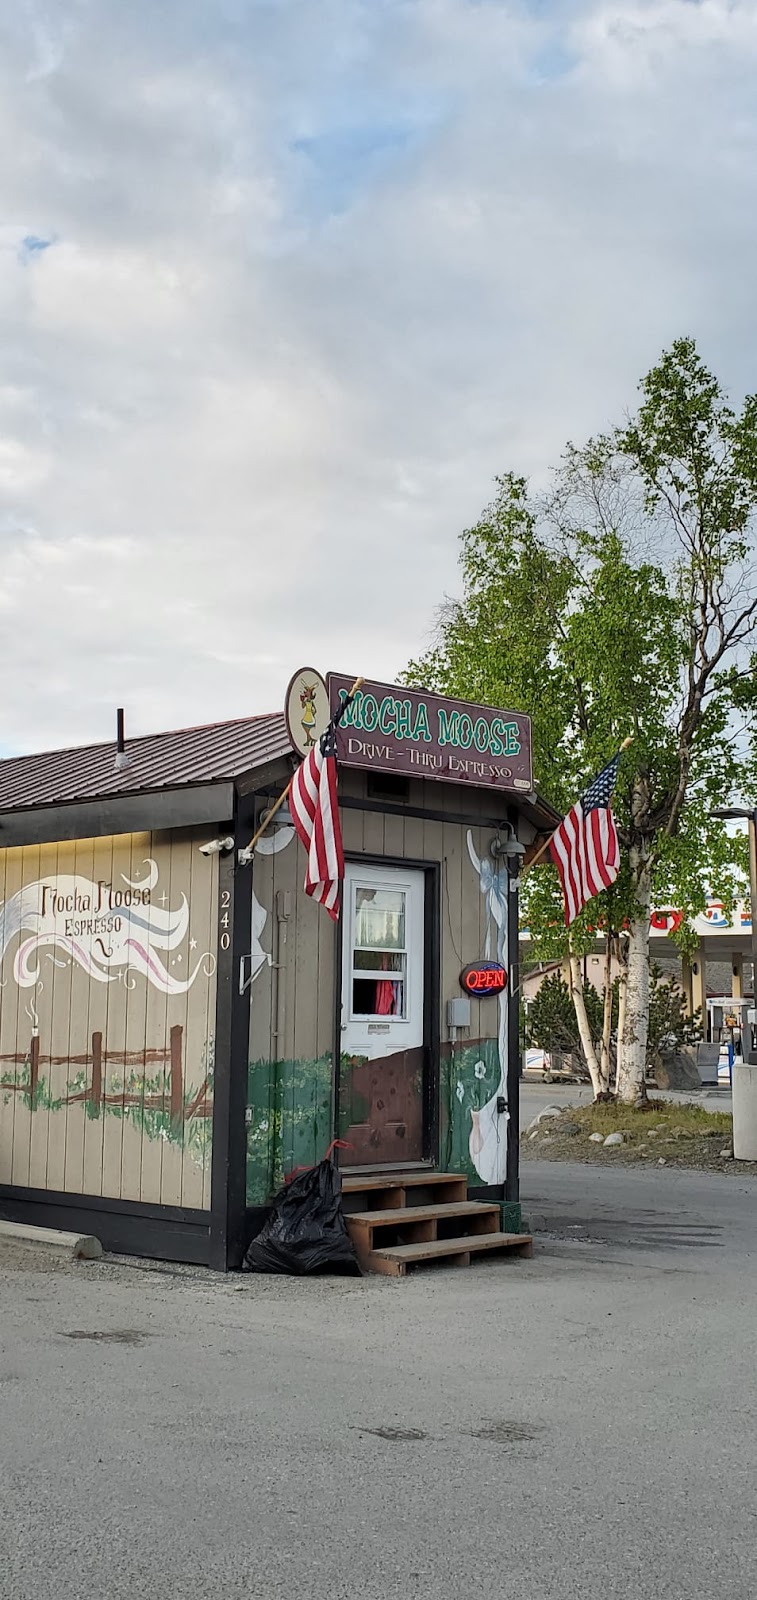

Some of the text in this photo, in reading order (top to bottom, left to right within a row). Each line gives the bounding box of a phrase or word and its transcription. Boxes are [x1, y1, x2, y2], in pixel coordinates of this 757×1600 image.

[338, 688, 521, 757] MOCHA MOOSE
[448, 755, 512, 778] ESPRESSO
[41, 880, 151, 918] Mocha Moose
[65, 916, 121, 937] ESPRESSO
[466, 970, 505, 989] OPEN
